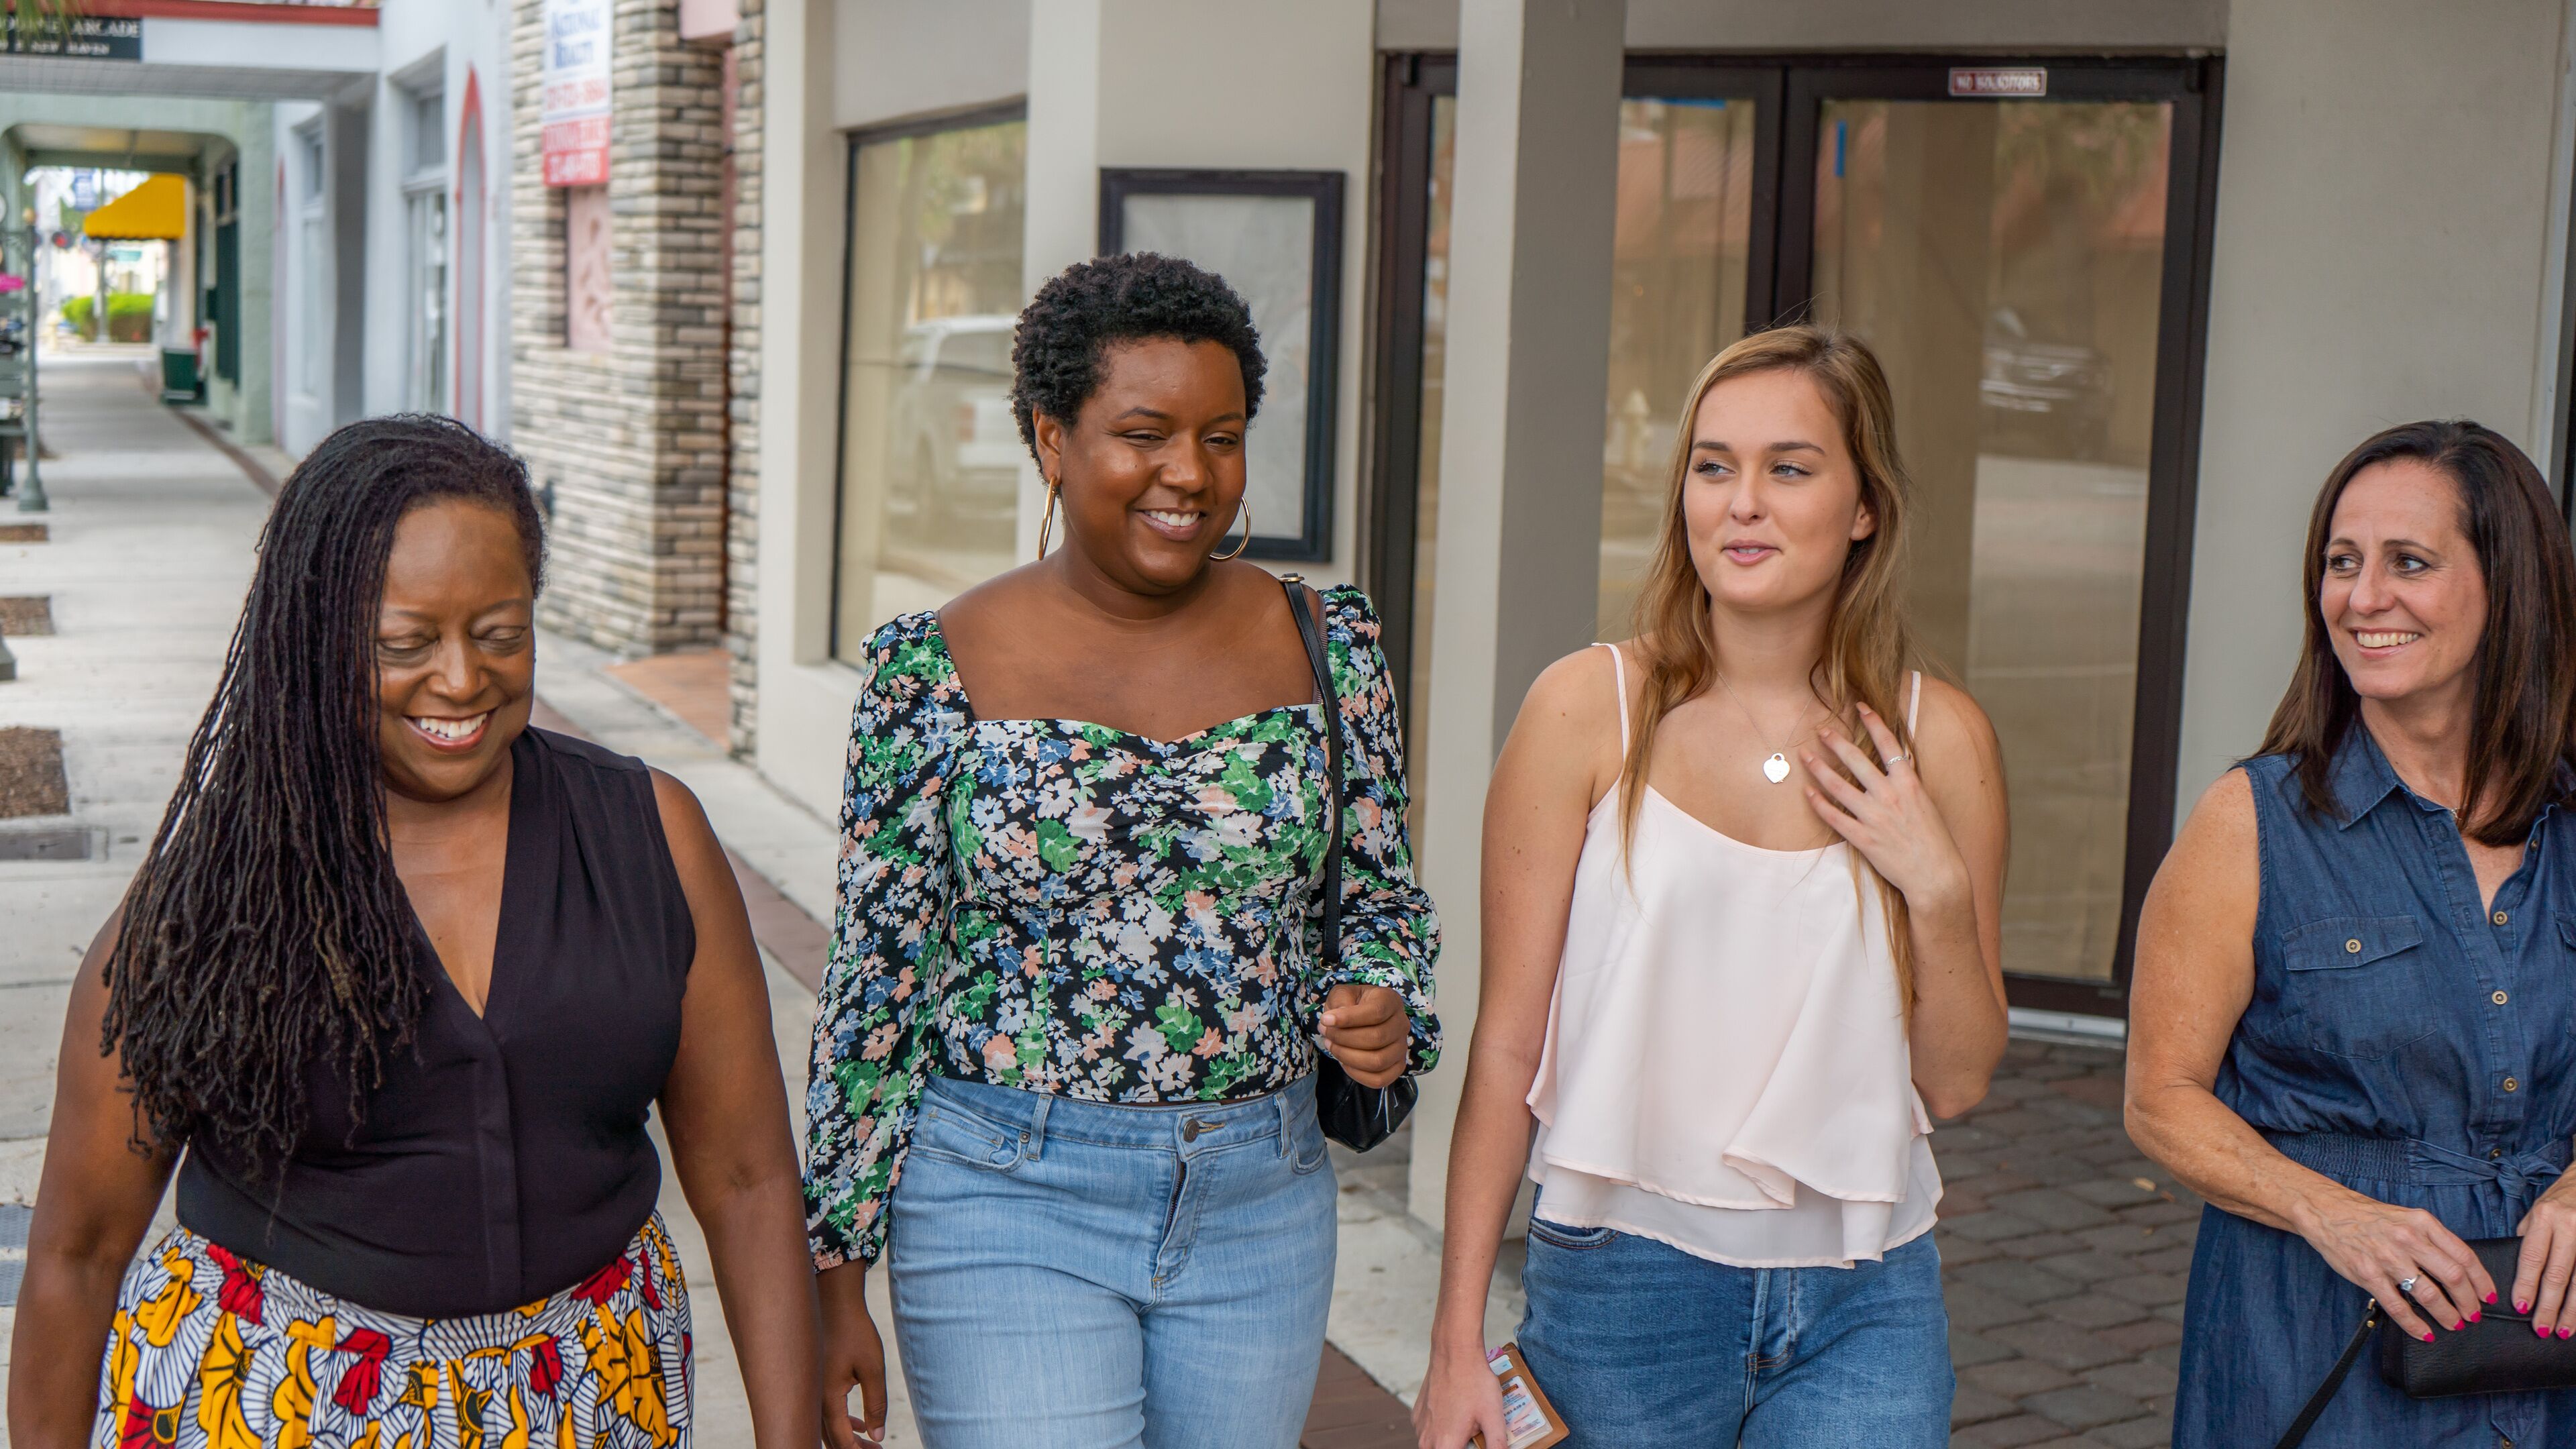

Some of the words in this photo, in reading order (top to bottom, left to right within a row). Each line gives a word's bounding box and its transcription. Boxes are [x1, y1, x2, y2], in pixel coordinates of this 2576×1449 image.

[71, 19, 140, 38] ARCADE
[1956, 74, 1973, 90] NO
[1976, 74, 2040, 91] SOLICITORS
